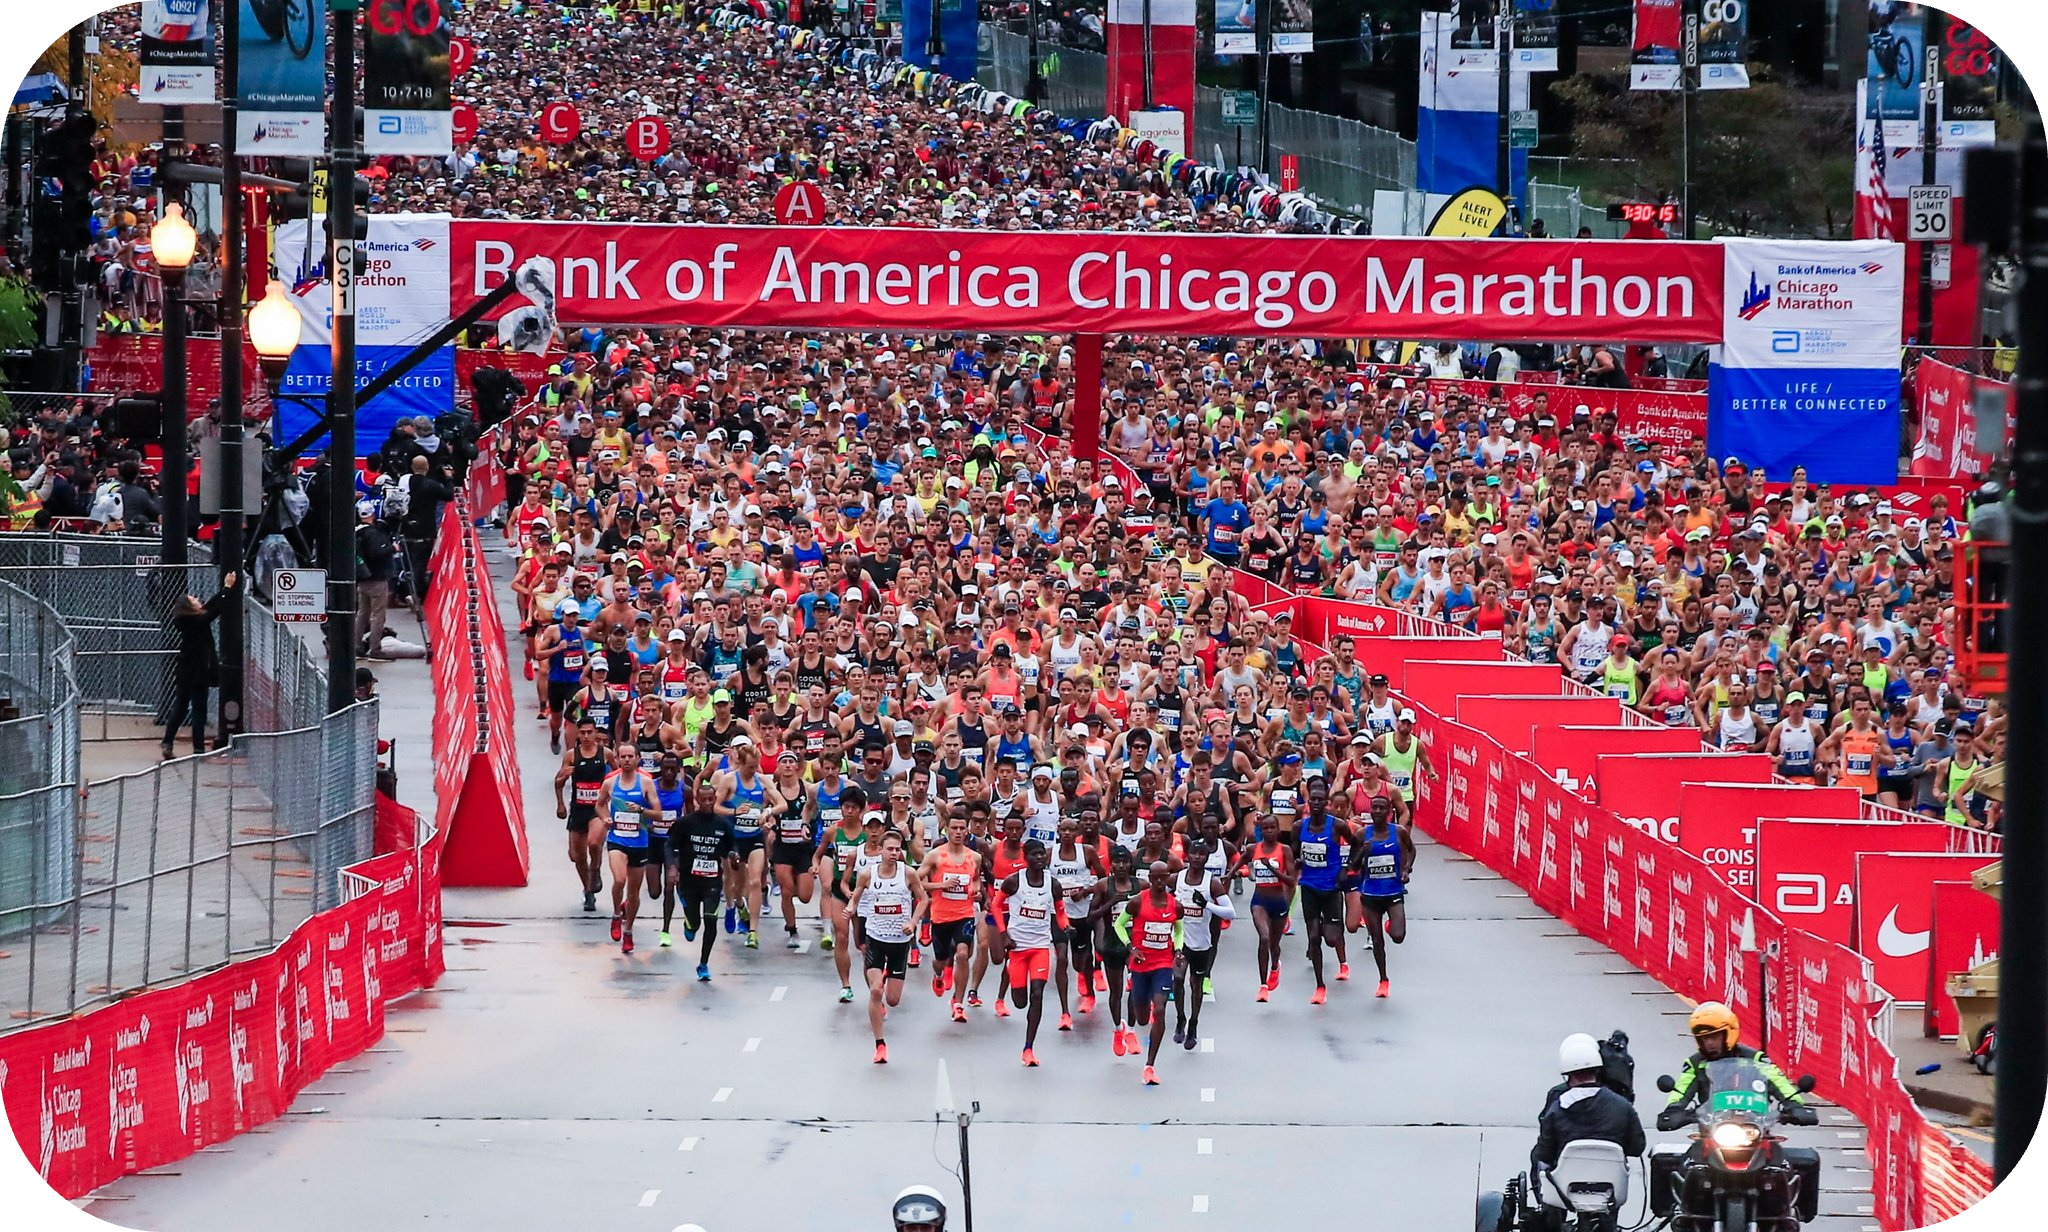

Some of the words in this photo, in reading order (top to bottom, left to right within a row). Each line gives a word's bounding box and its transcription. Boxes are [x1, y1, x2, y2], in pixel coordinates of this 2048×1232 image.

[369, 0, 440, 36] GO
[1703, 0, 1741, 23] GO
[150, 50, 208, 58] #ChicagoMarathon
[1945, 50, 1991, 77] GO
[248, 93, 316, 102] #ChicagoMarathon
[451, 105, 467, 132] C
[549, 105, 569, 132] C
[638, 121, 659, 149] B
[1140, 128, 1180, 138] aggreko
[785, 185, 814, 218] A
[1912, 190, 1949, 200] SPEED
[1462, 201, 1493, 217] ALERT
[1916, 201, 1944, 210] LIMIT
[1459, 212, 1489, 229] LEVEL
[1914, 213, 1946, 233] 30
[368, 242, 410, 252] America
[365, 260, 392, 274] ago
[1777, 265, 1804, 275] Bank
[1804, 265, 1815, 275] of
[1815, 265, 1857, 275] America
[355, 274, 407, 287] rathon
[665, 243, 739, 302] of
[758, 246, 1040, 309] America
[1067, 250, 1338, 329] Chicago
[1365, 256, 1694, 319] Marathon
[1777, 280, 1838, 297] Chicago
[1777, 296, 1853, 310] Marathon
[286, 375, 333, 387] BETTE
[1786, 382, 1818, 394] LIFE
[1825, 382, 1833, 394] /
[1637, 403, 1661, 417] Bank
[1732, 398, 1788, 410] BETTER
[1795, 398, 1888, 411] CONNECTED
[735, 818, 752, 826] PACE
[1036, 831, 1051, 839] 479
[1320, 854, 1324, 862] 1
[1056, 868, 1078, 876] ARMY
[1145, 933, 1157, 942] SIR
[1725, 1094, 1744, 1105] TV
[1746, 1096, 1753, 1106] 1
